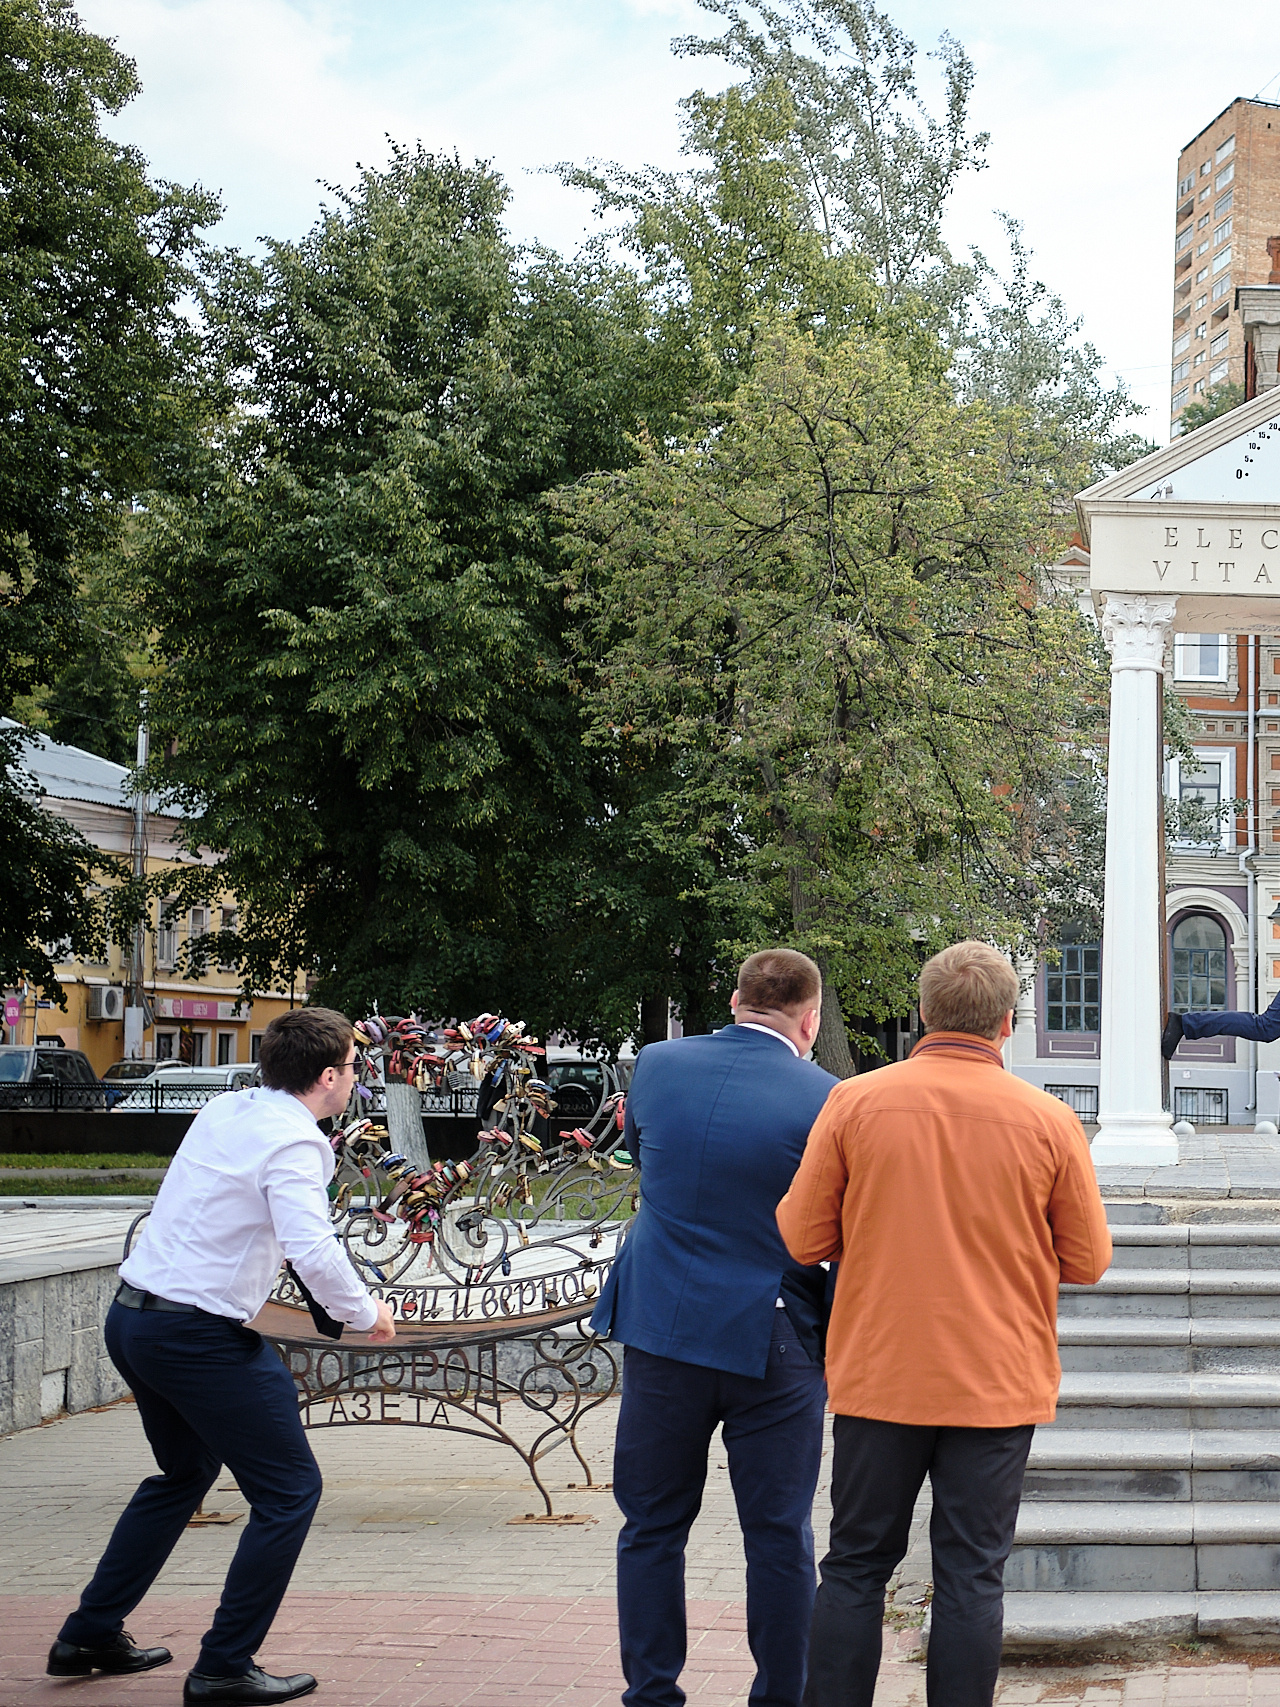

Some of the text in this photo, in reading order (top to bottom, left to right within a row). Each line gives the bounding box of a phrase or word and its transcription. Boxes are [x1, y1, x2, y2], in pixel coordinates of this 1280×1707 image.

[1268, 422, 1278, 430] 20
[1249, 442, 1257, 450] 10
[1244, 455, 1250, 463] 5
[1236, 468, 1243, 480] 0
